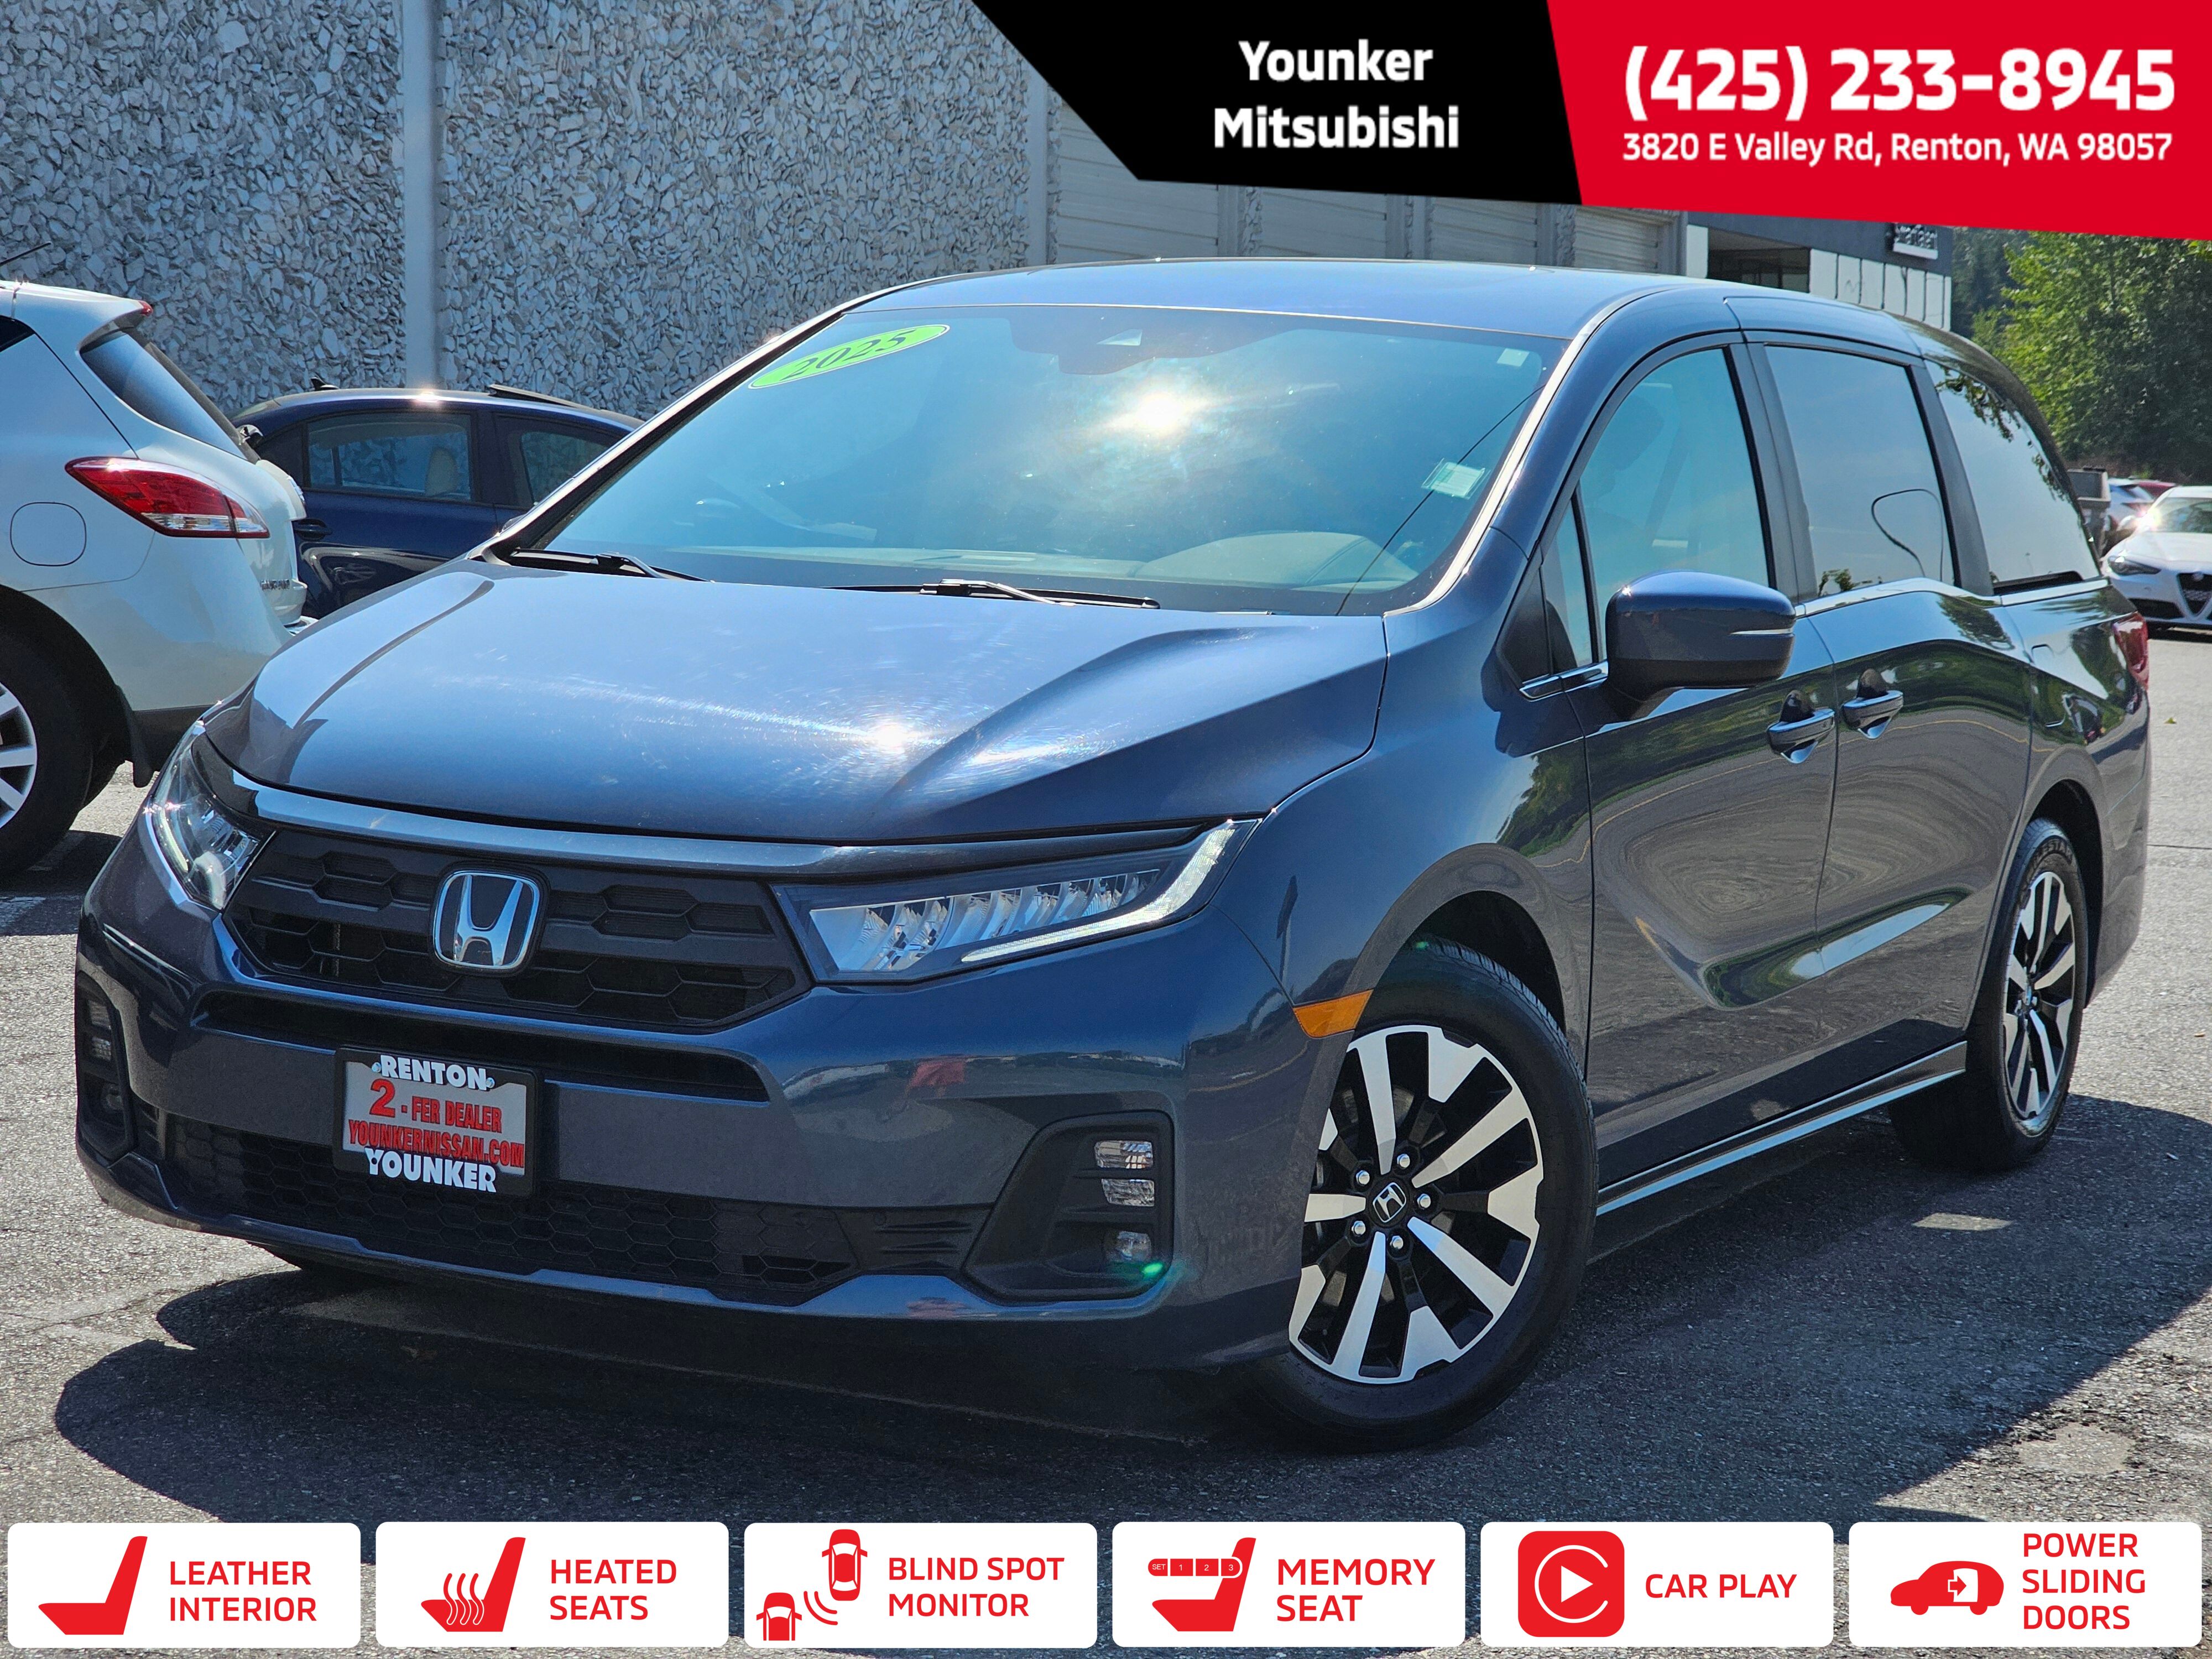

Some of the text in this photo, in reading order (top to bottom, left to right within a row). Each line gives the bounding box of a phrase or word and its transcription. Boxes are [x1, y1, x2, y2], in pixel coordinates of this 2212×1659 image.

[779, 329, 917, 381] 2025
[380, 1054, 487, 1091] RENTON
[369, 1078, 395, 1118] 2
[411, 1095, 440, 1124] FER
[445, 1100, 502, 1133] DEALER
[348, 1119, 524, 1168] YOUNKERNISSAN.COM
[364, 1147, 497, 1192] YOUNKER
